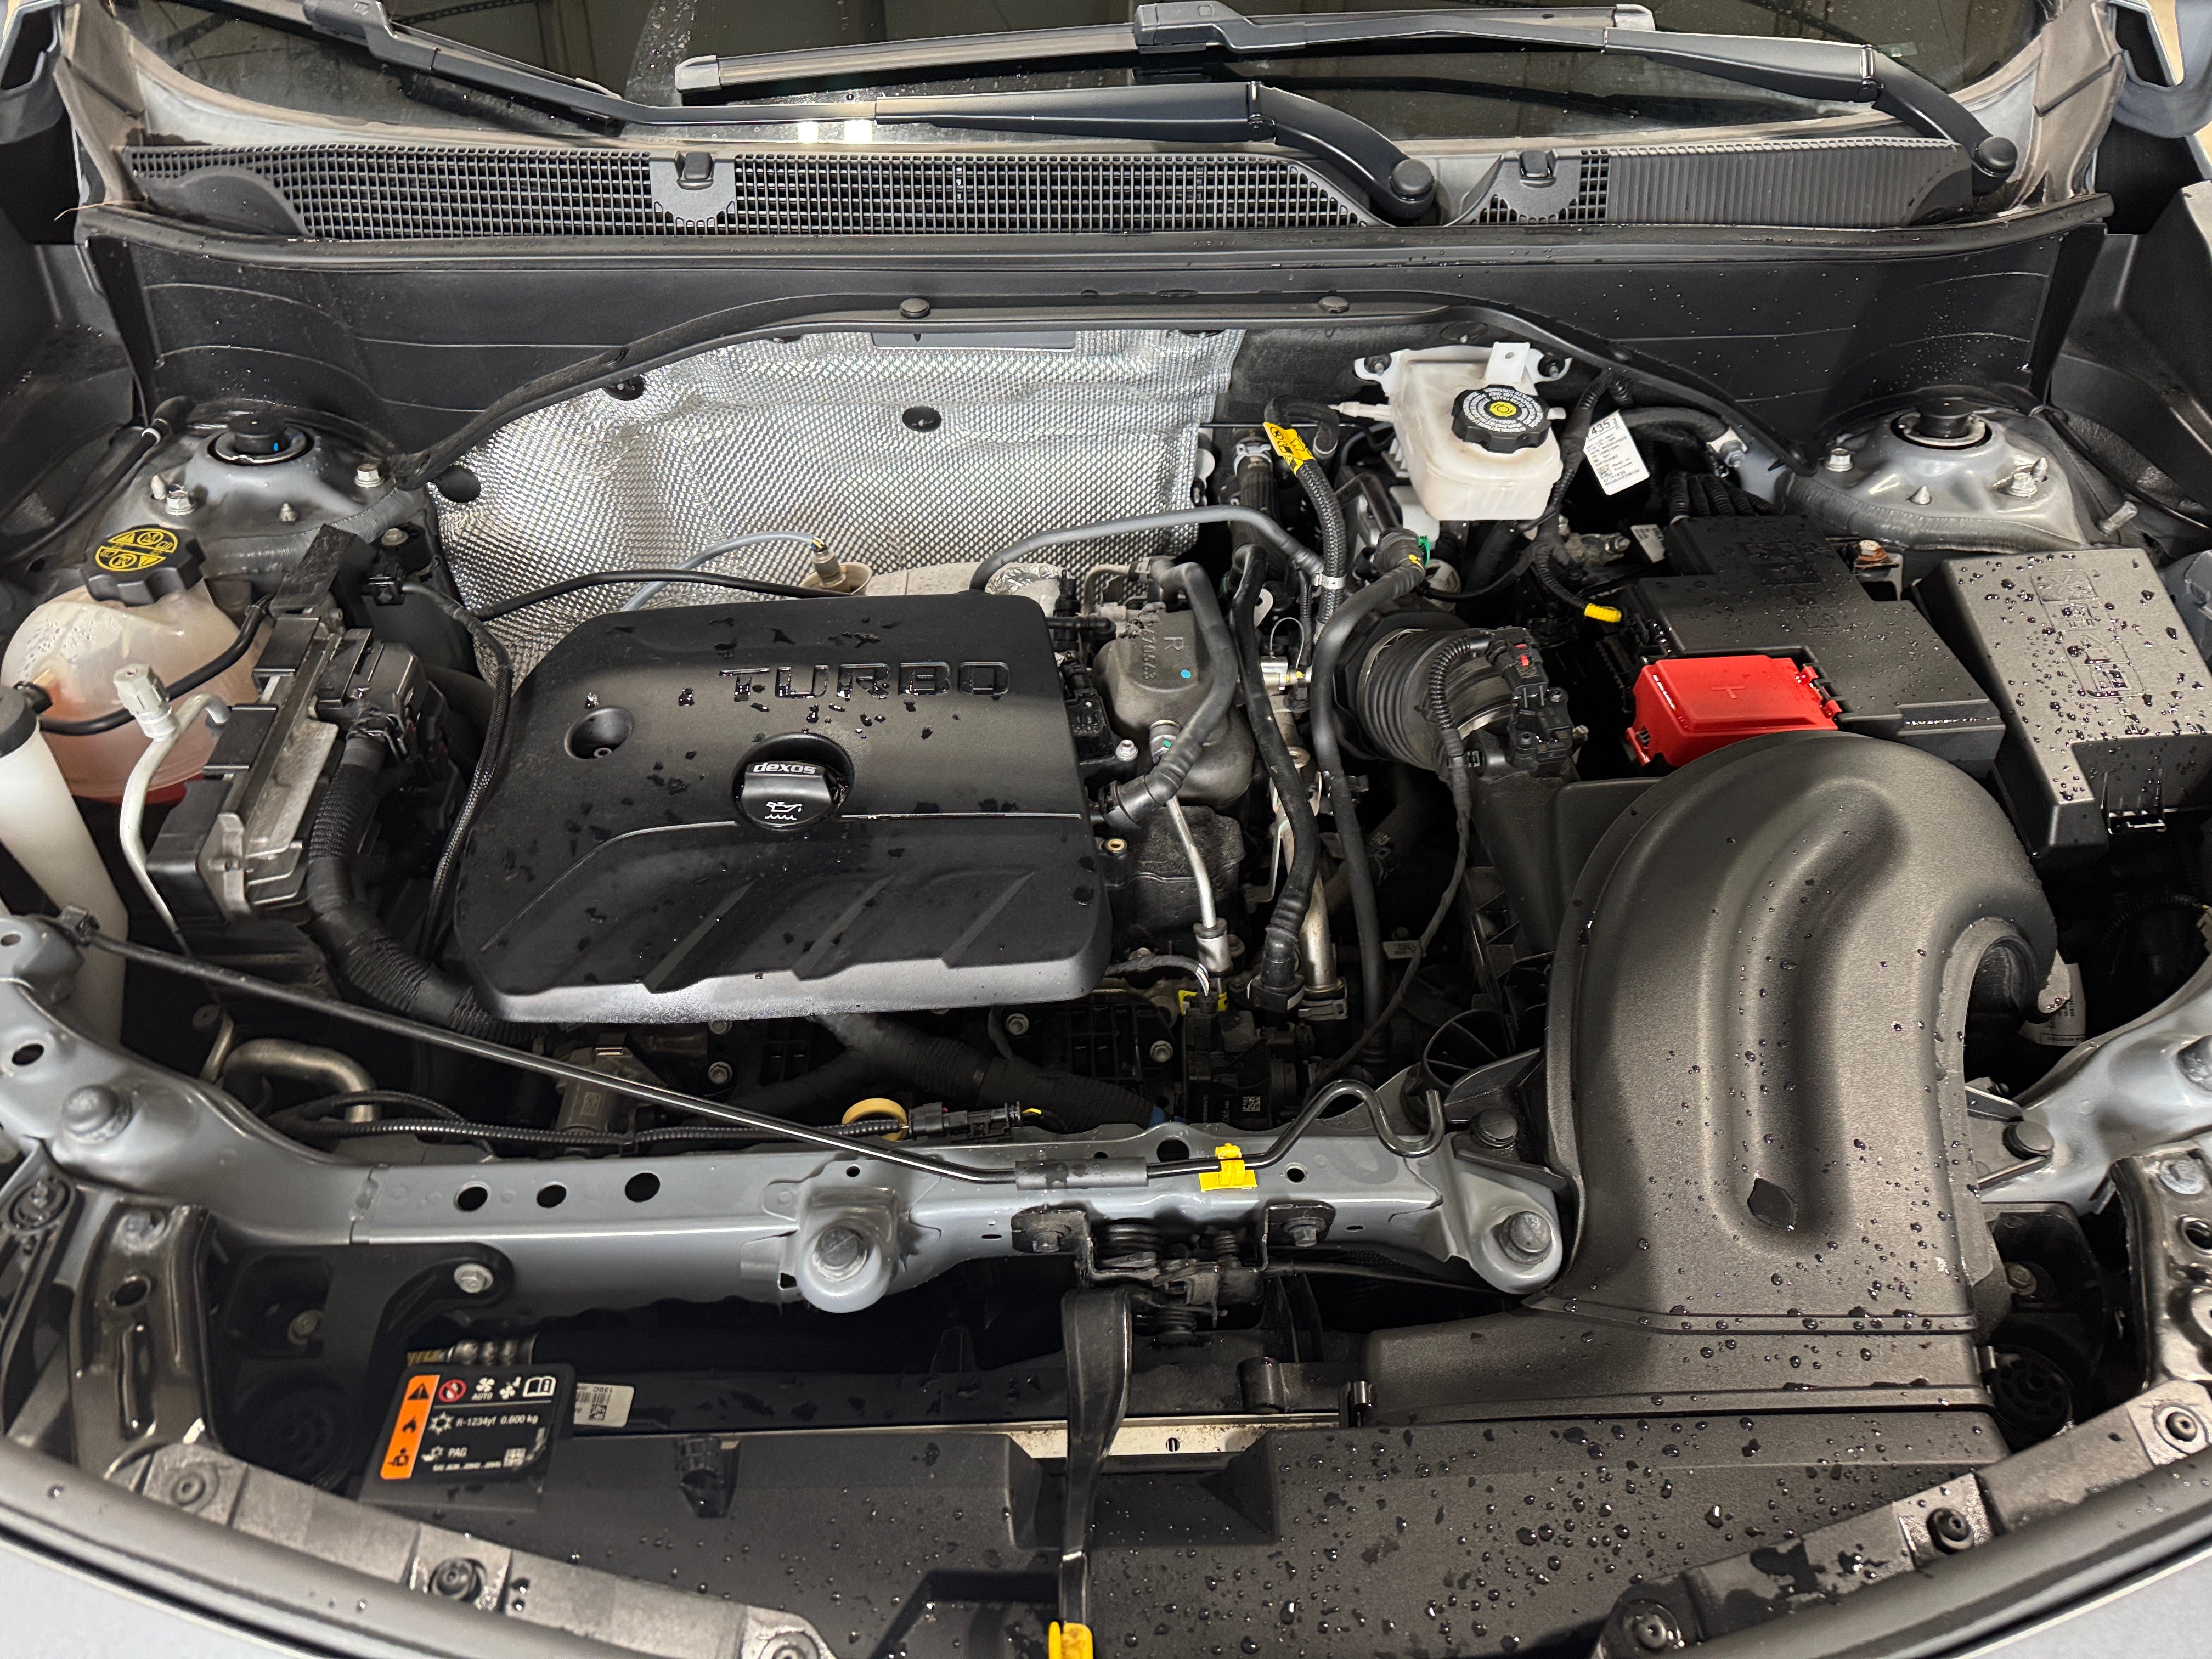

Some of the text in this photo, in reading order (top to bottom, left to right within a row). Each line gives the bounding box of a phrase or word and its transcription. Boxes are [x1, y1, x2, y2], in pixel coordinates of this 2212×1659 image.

[1163, 636, 1184, 651] R
[718, 661, 1010, 701] TURBO
[753, 761, 816, 775] dexos
[471, 1392, 493, 1401] AUTO
[455, 1415, 497, 1427] R-1234yf
[527, 1414, 539, 1425] kg
[448, 1446, 468, 1459] PAG
